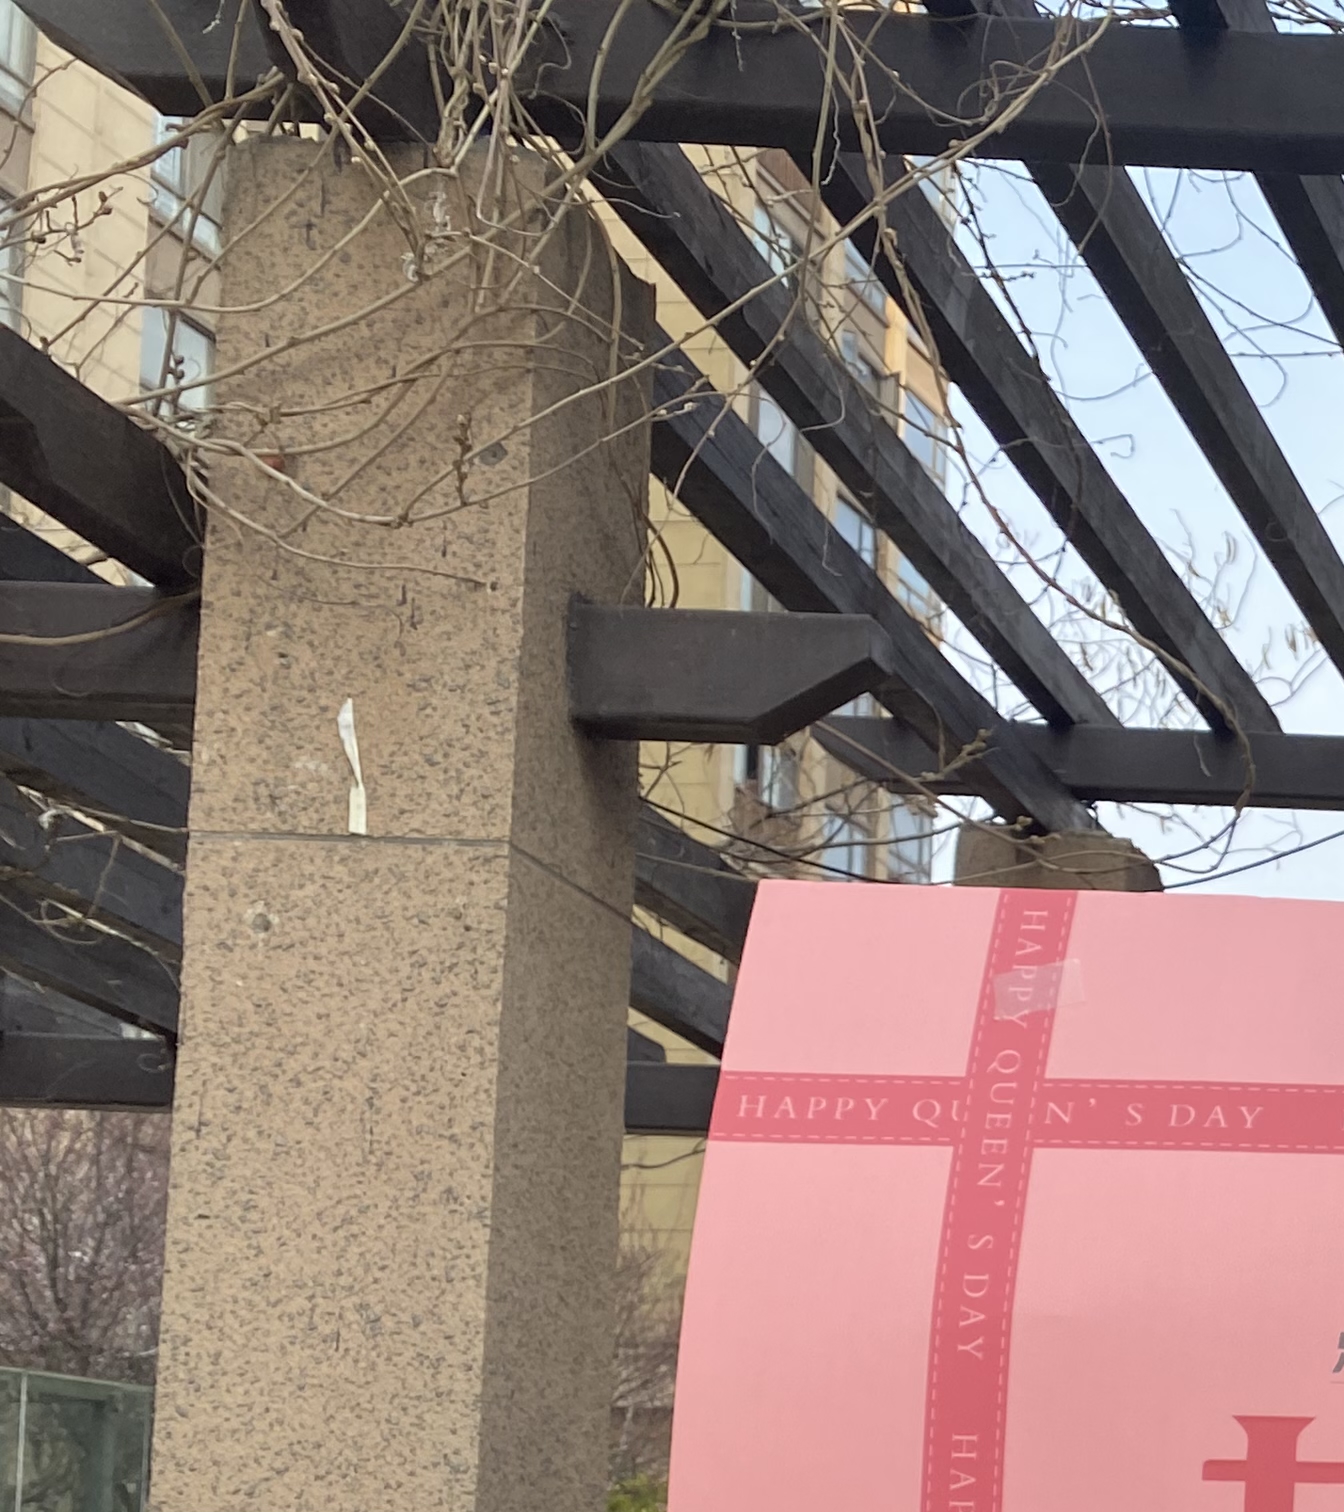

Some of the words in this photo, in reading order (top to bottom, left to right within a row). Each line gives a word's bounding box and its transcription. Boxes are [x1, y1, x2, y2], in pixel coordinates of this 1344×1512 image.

[1003, 911, 1048, 1028] HAPPY
[736, 1095, 888, 1121] HAPPY
[1169, 1104, 1264, 1128] DAY
[957, 1273, 989, 1361] DAY
